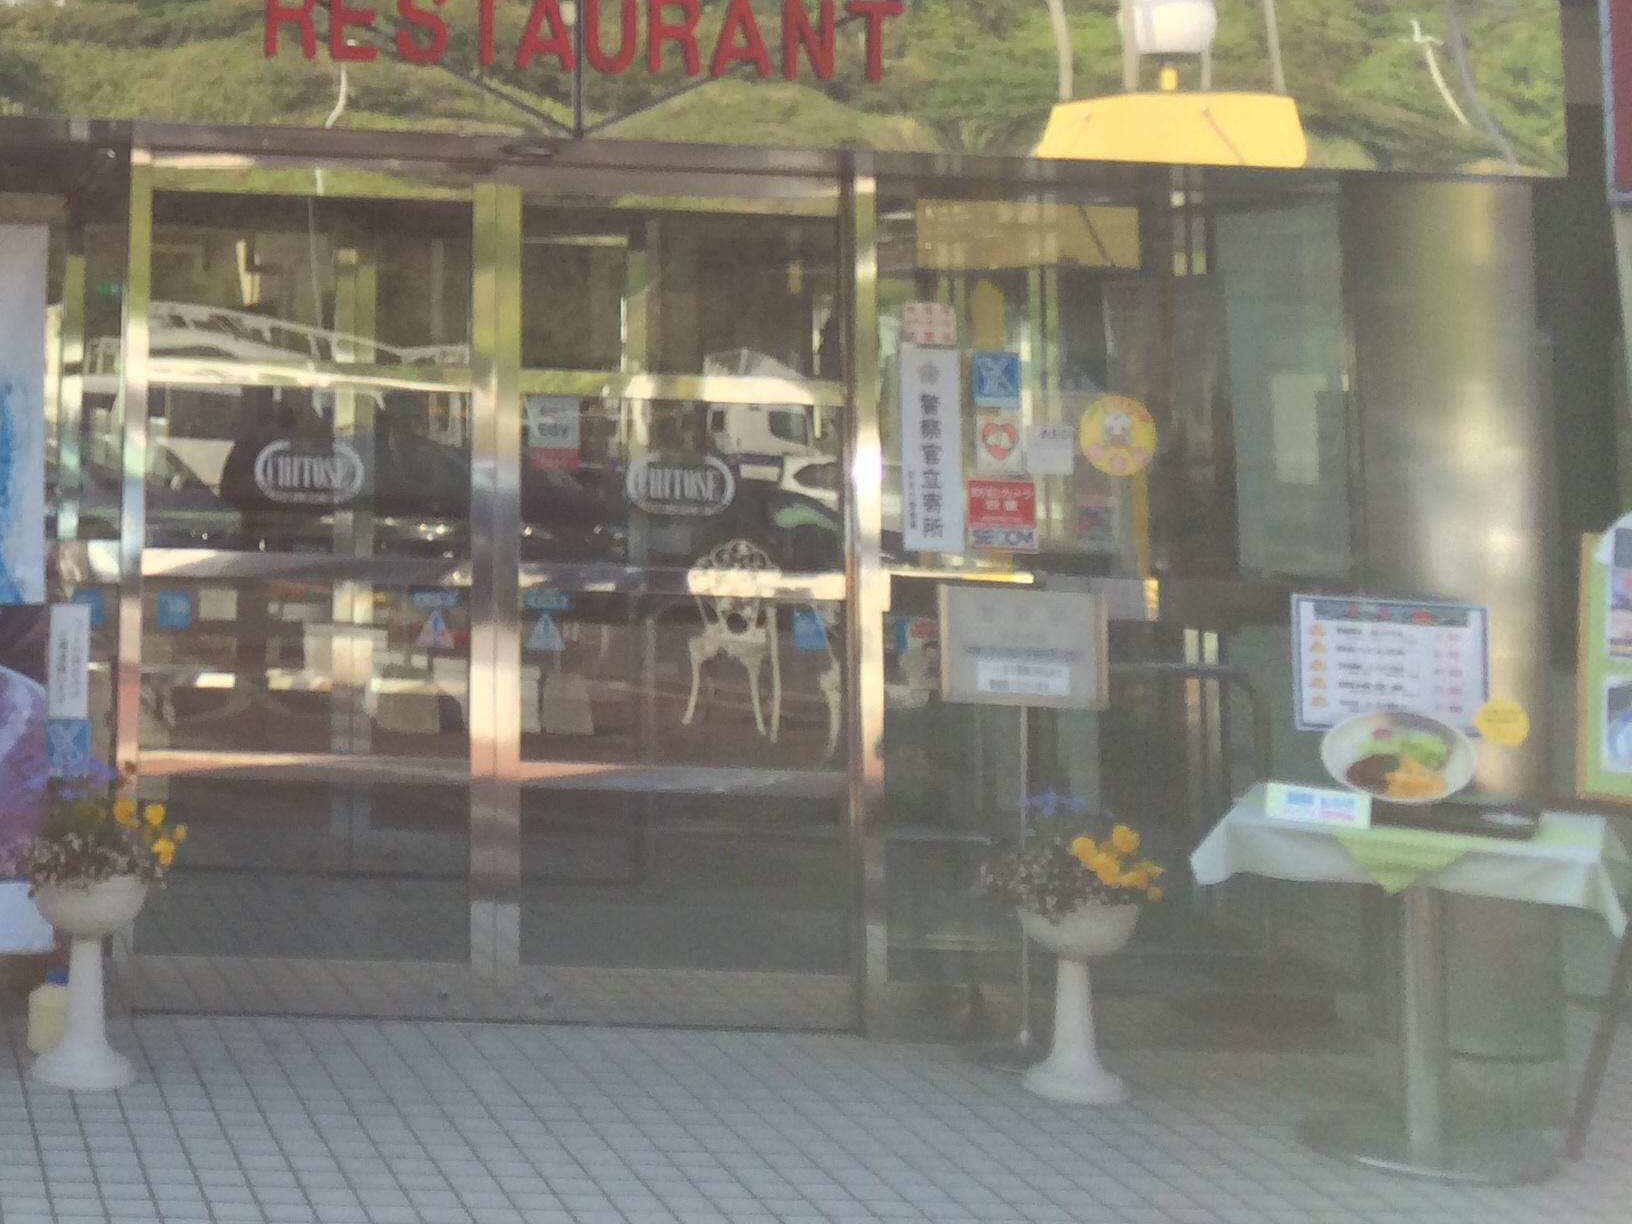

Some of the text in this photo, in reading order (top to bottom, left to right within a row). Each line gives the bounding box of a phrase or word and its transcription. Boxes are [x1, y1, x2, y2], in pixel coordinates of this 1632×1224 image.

[919, 393, 944, 538] 警察官立寄所
